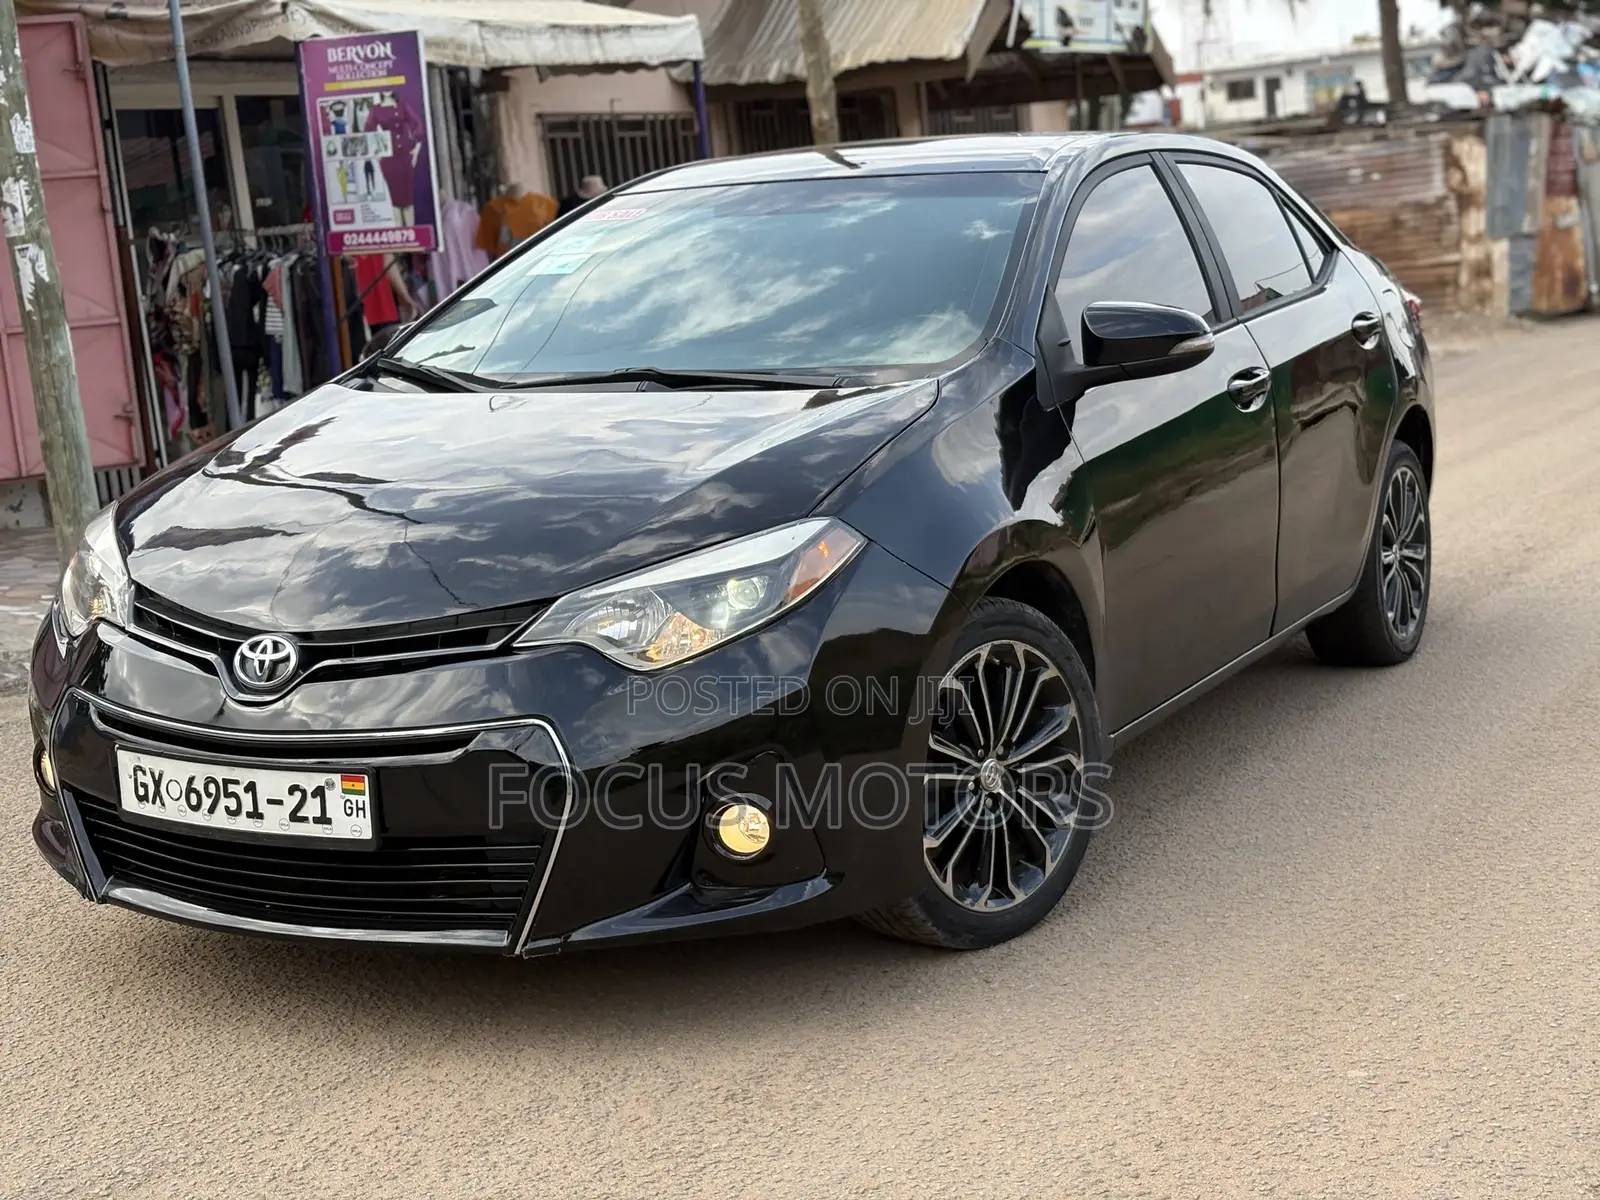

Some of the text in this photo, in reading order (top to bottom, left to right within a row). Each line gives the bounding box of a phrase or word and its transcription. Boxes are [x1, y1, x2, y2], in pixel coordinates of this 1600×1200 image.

[327, 41, 397, 64] BERVON
[132, 764, 333, 825] GX 6951-21
[343, 798, 367, 820] GH
